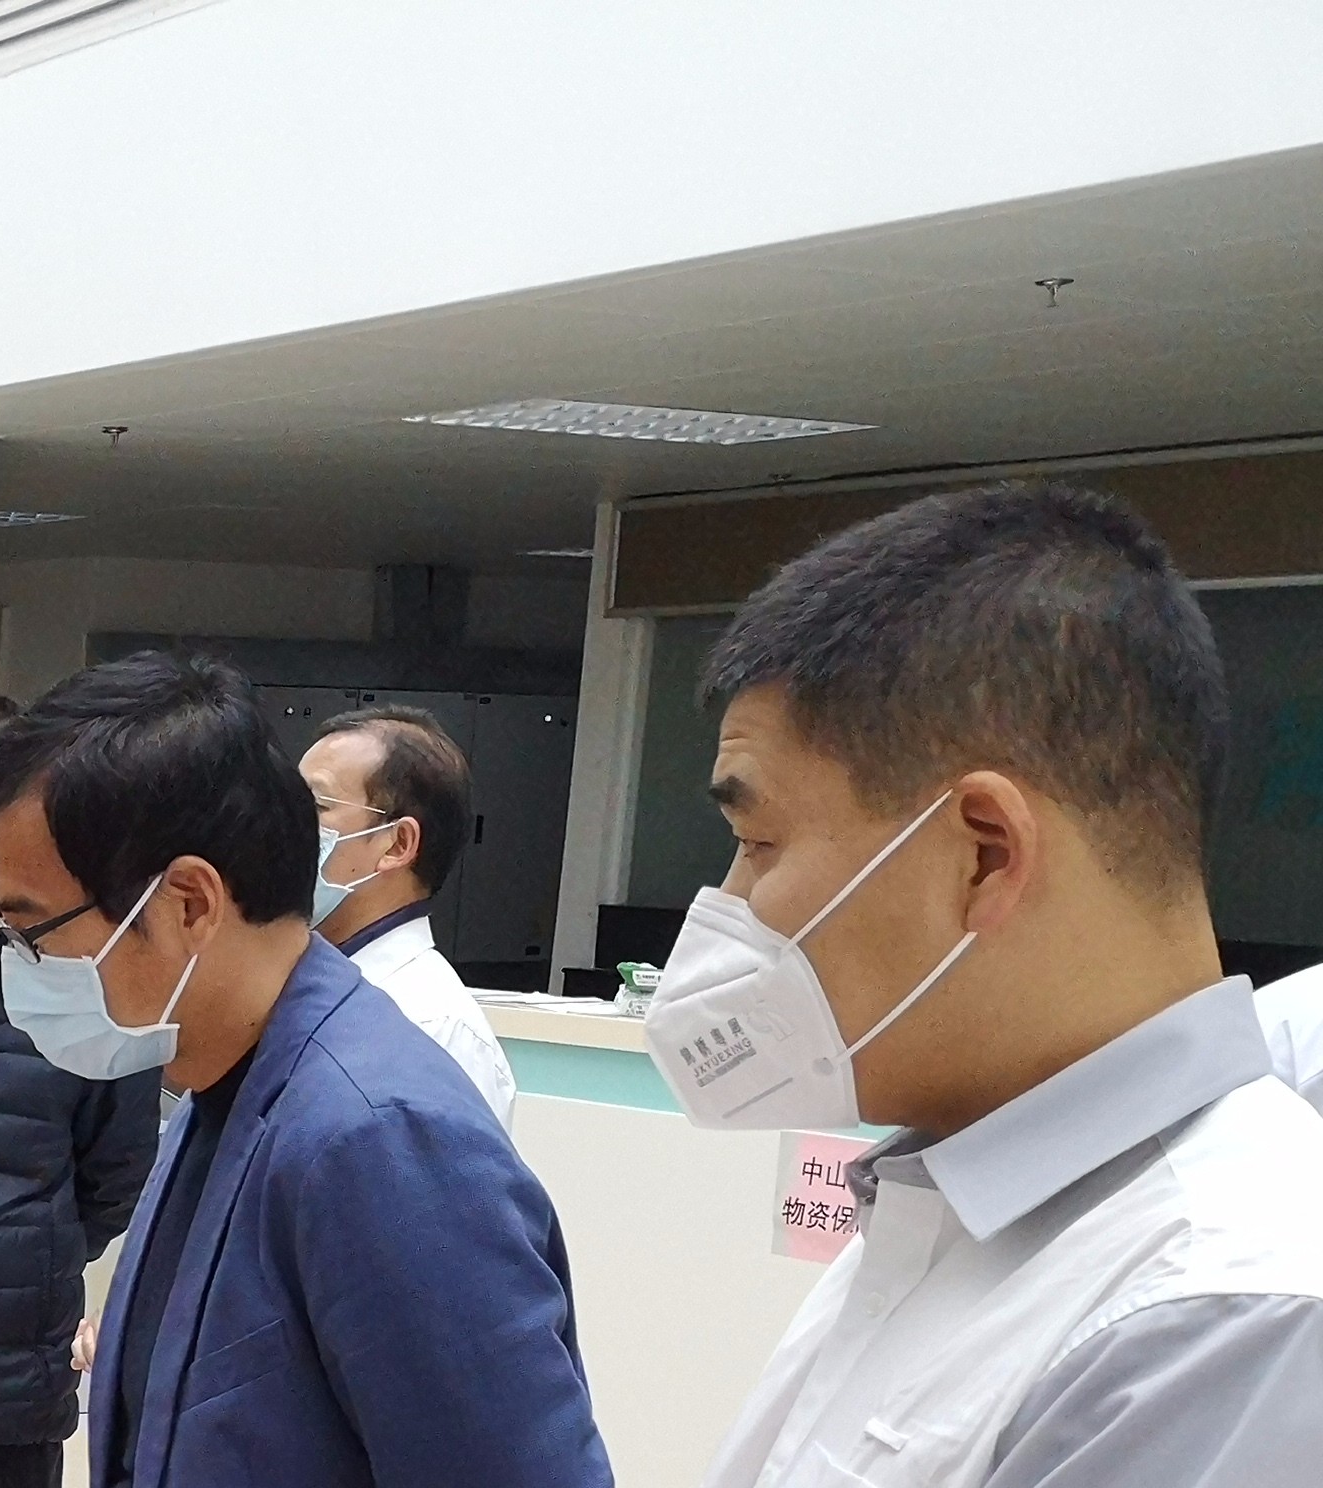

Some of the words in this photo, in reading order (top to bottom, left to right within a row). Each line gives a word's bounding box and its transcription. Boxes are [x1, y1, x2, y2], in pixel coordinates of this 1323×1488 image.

[801, 1156, 846, 1190] 中山
[782, 1196, 859, 1234] 物资保
